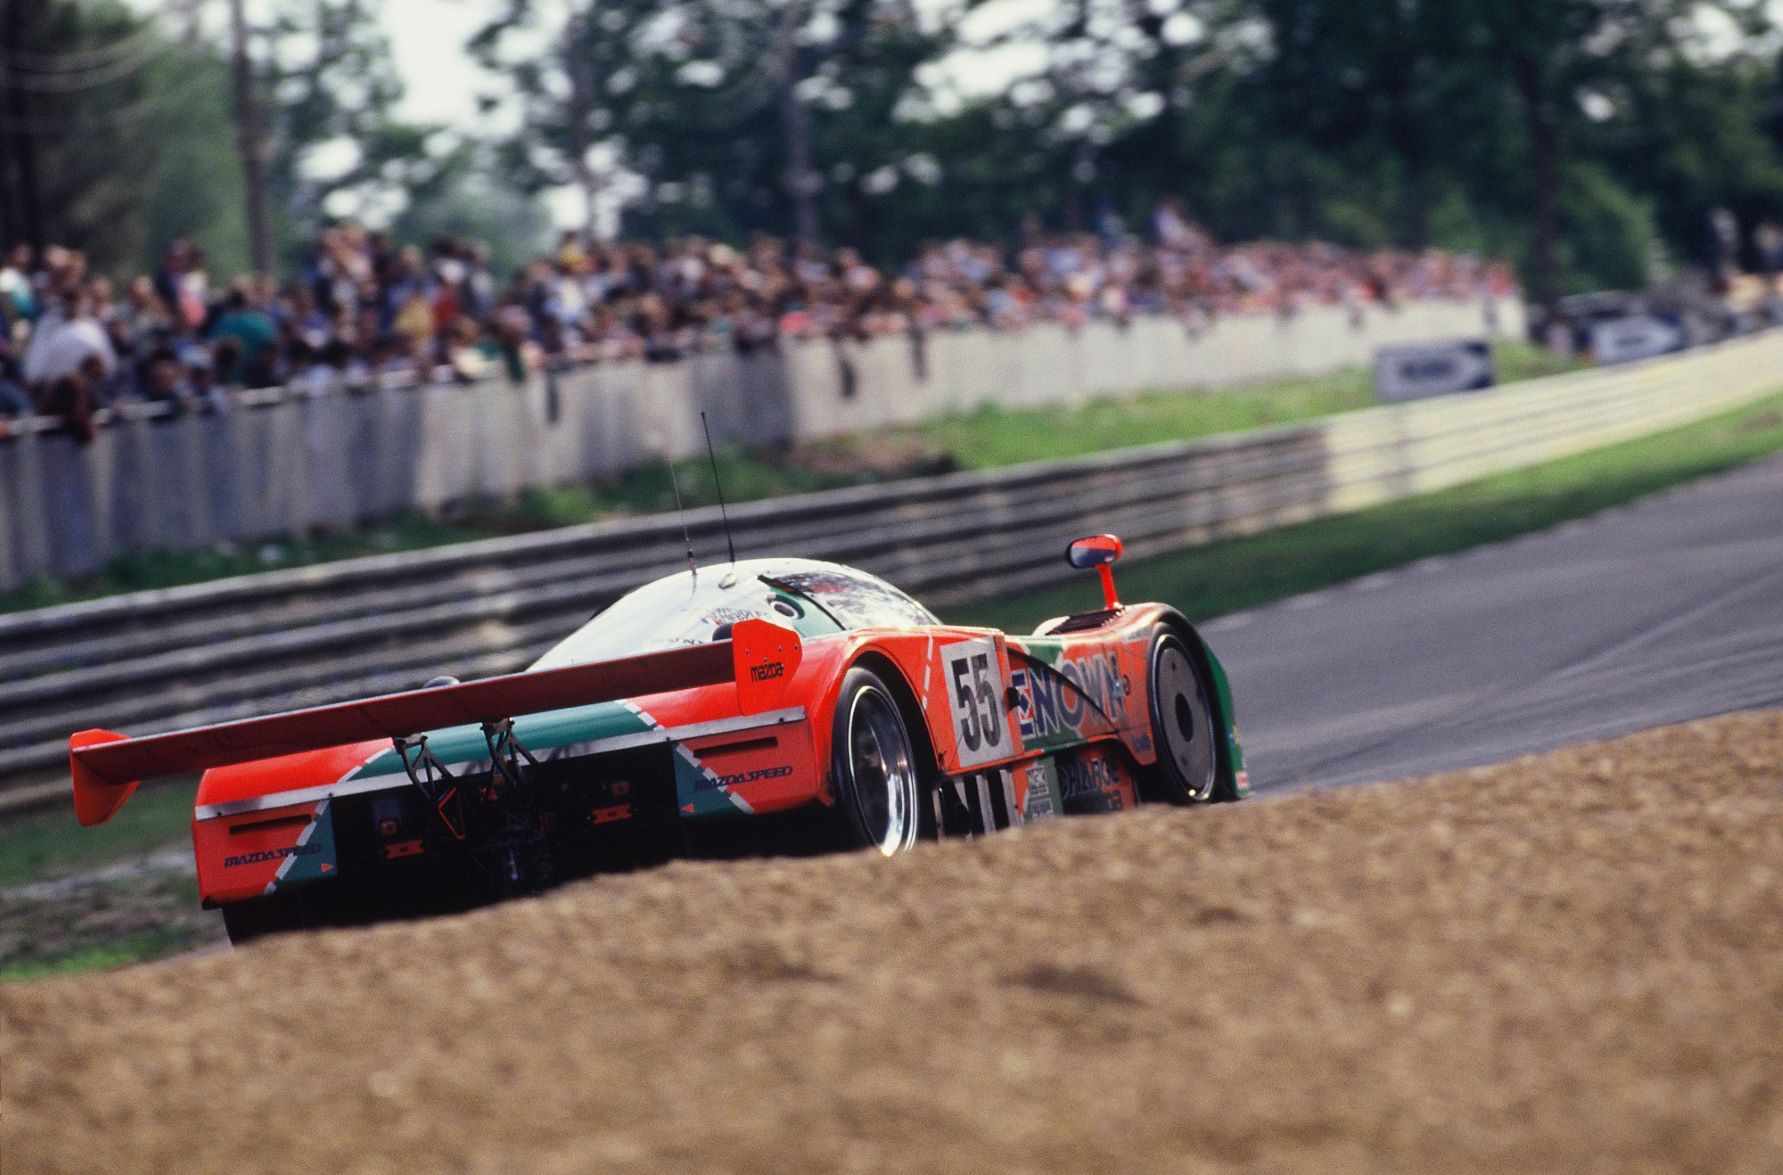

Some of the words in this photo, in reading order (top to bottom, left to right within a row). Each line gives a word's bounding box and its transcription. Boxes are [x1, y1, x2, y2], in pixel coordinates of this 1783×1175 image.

[750, 662, 784, 682] mazda
[951, 653, 1000, 752] 55
[1010, 651, 1126, 739] ENOWN
[694, 765, 793, 791] MAZDASPEED
[224, 843, 322, 868] MAZDASPEED
